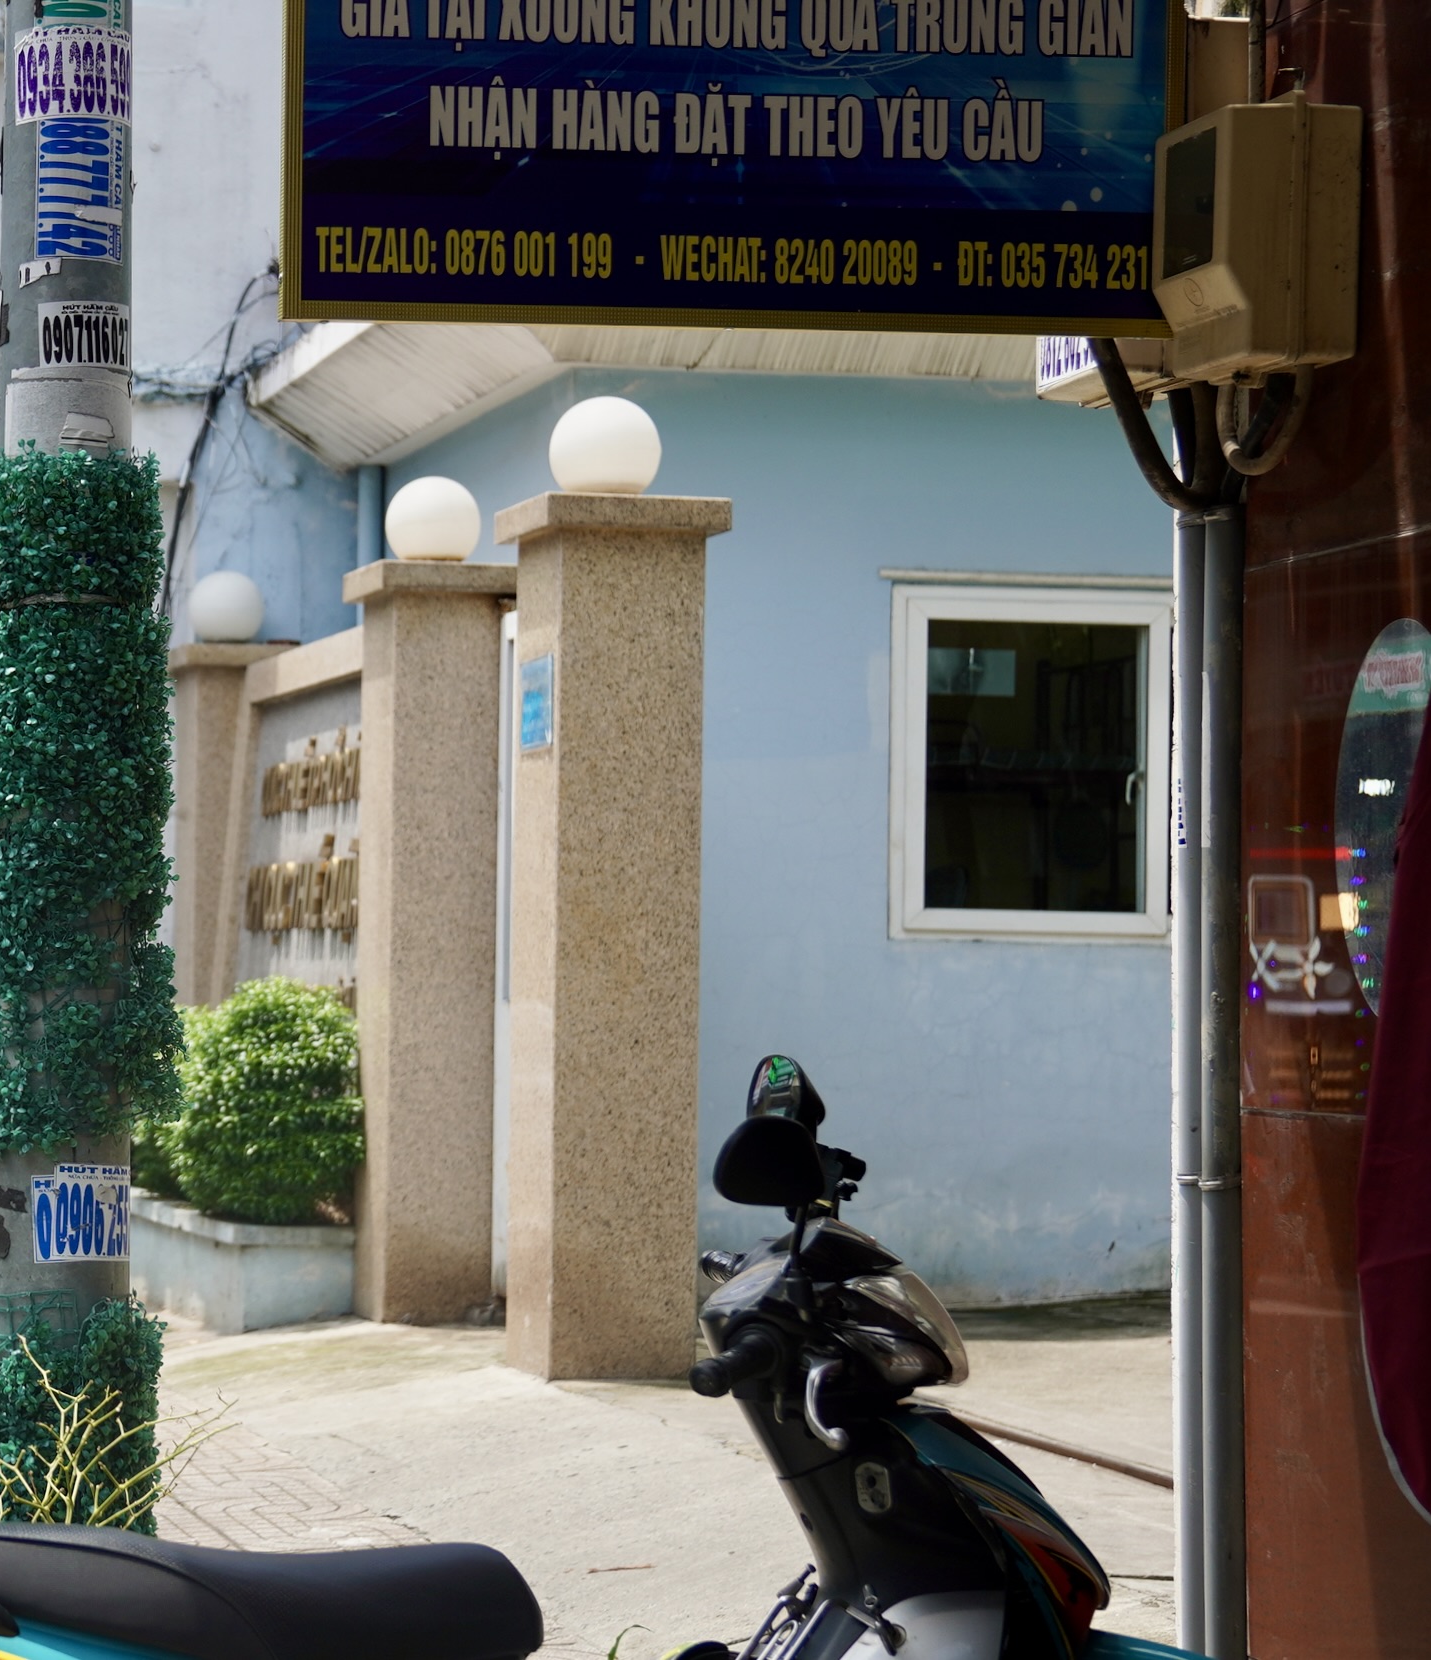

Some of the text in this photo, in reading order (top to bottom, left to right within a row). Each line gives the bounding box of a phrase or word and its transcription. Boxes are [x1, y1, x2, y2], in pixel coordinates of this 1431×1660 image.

[800, 0, 879, 57] QUA
[891, 0, 1025, 55] TRUNG
[1038, 0, 1132, 57] GIAN
[430, 76, 1044, 166] NHẬN HÀNG ĐẶT THEO YÊU CẦU
[316, 226, 437, 274] TEL/ZALO:
[445, 229, 505, 276] 0876
[514, 231, 556, 277] 001
[568, 232, 612, 279] 199
[660, 234, 766, 283] WECHAT:
[775, 238, 834, 285] 8240
[843, 239, 917, 286] 20089
[957, 241, 993, 287] ĐT:
[1001, 242, 1045, 288] 035
[1054, 243, 1098, 289] 734
[1107, 244, 1147, 290] 231
